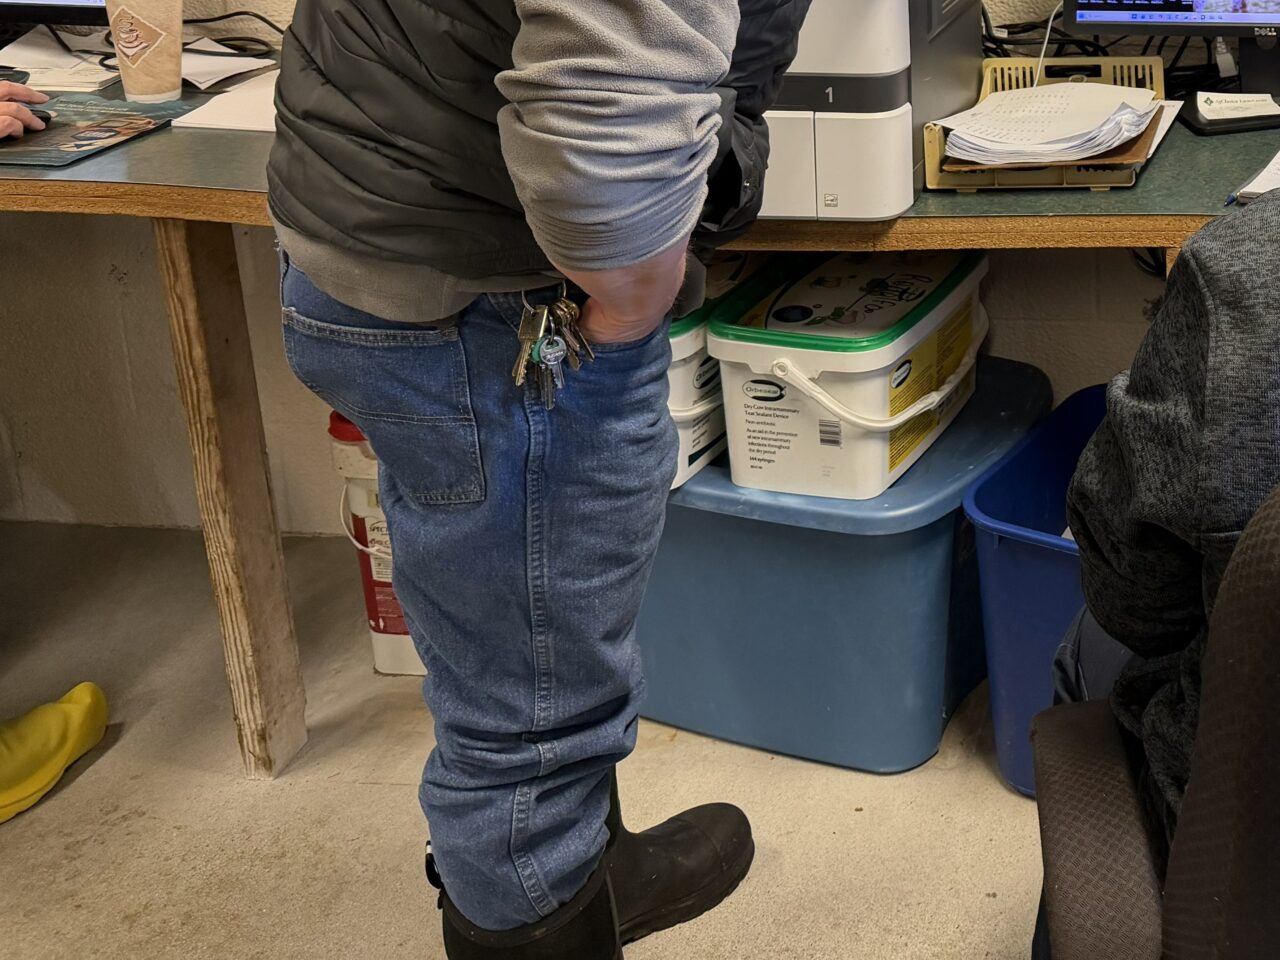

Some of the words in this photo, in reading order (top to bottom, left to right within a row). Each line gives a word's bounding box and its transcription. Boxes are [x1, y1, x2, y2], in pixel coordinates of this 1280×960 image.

[1254, 27, 1277, 36] DELL
[825, 86, 833, 103] 1
[765, 405, 800, 414] Intramammary
